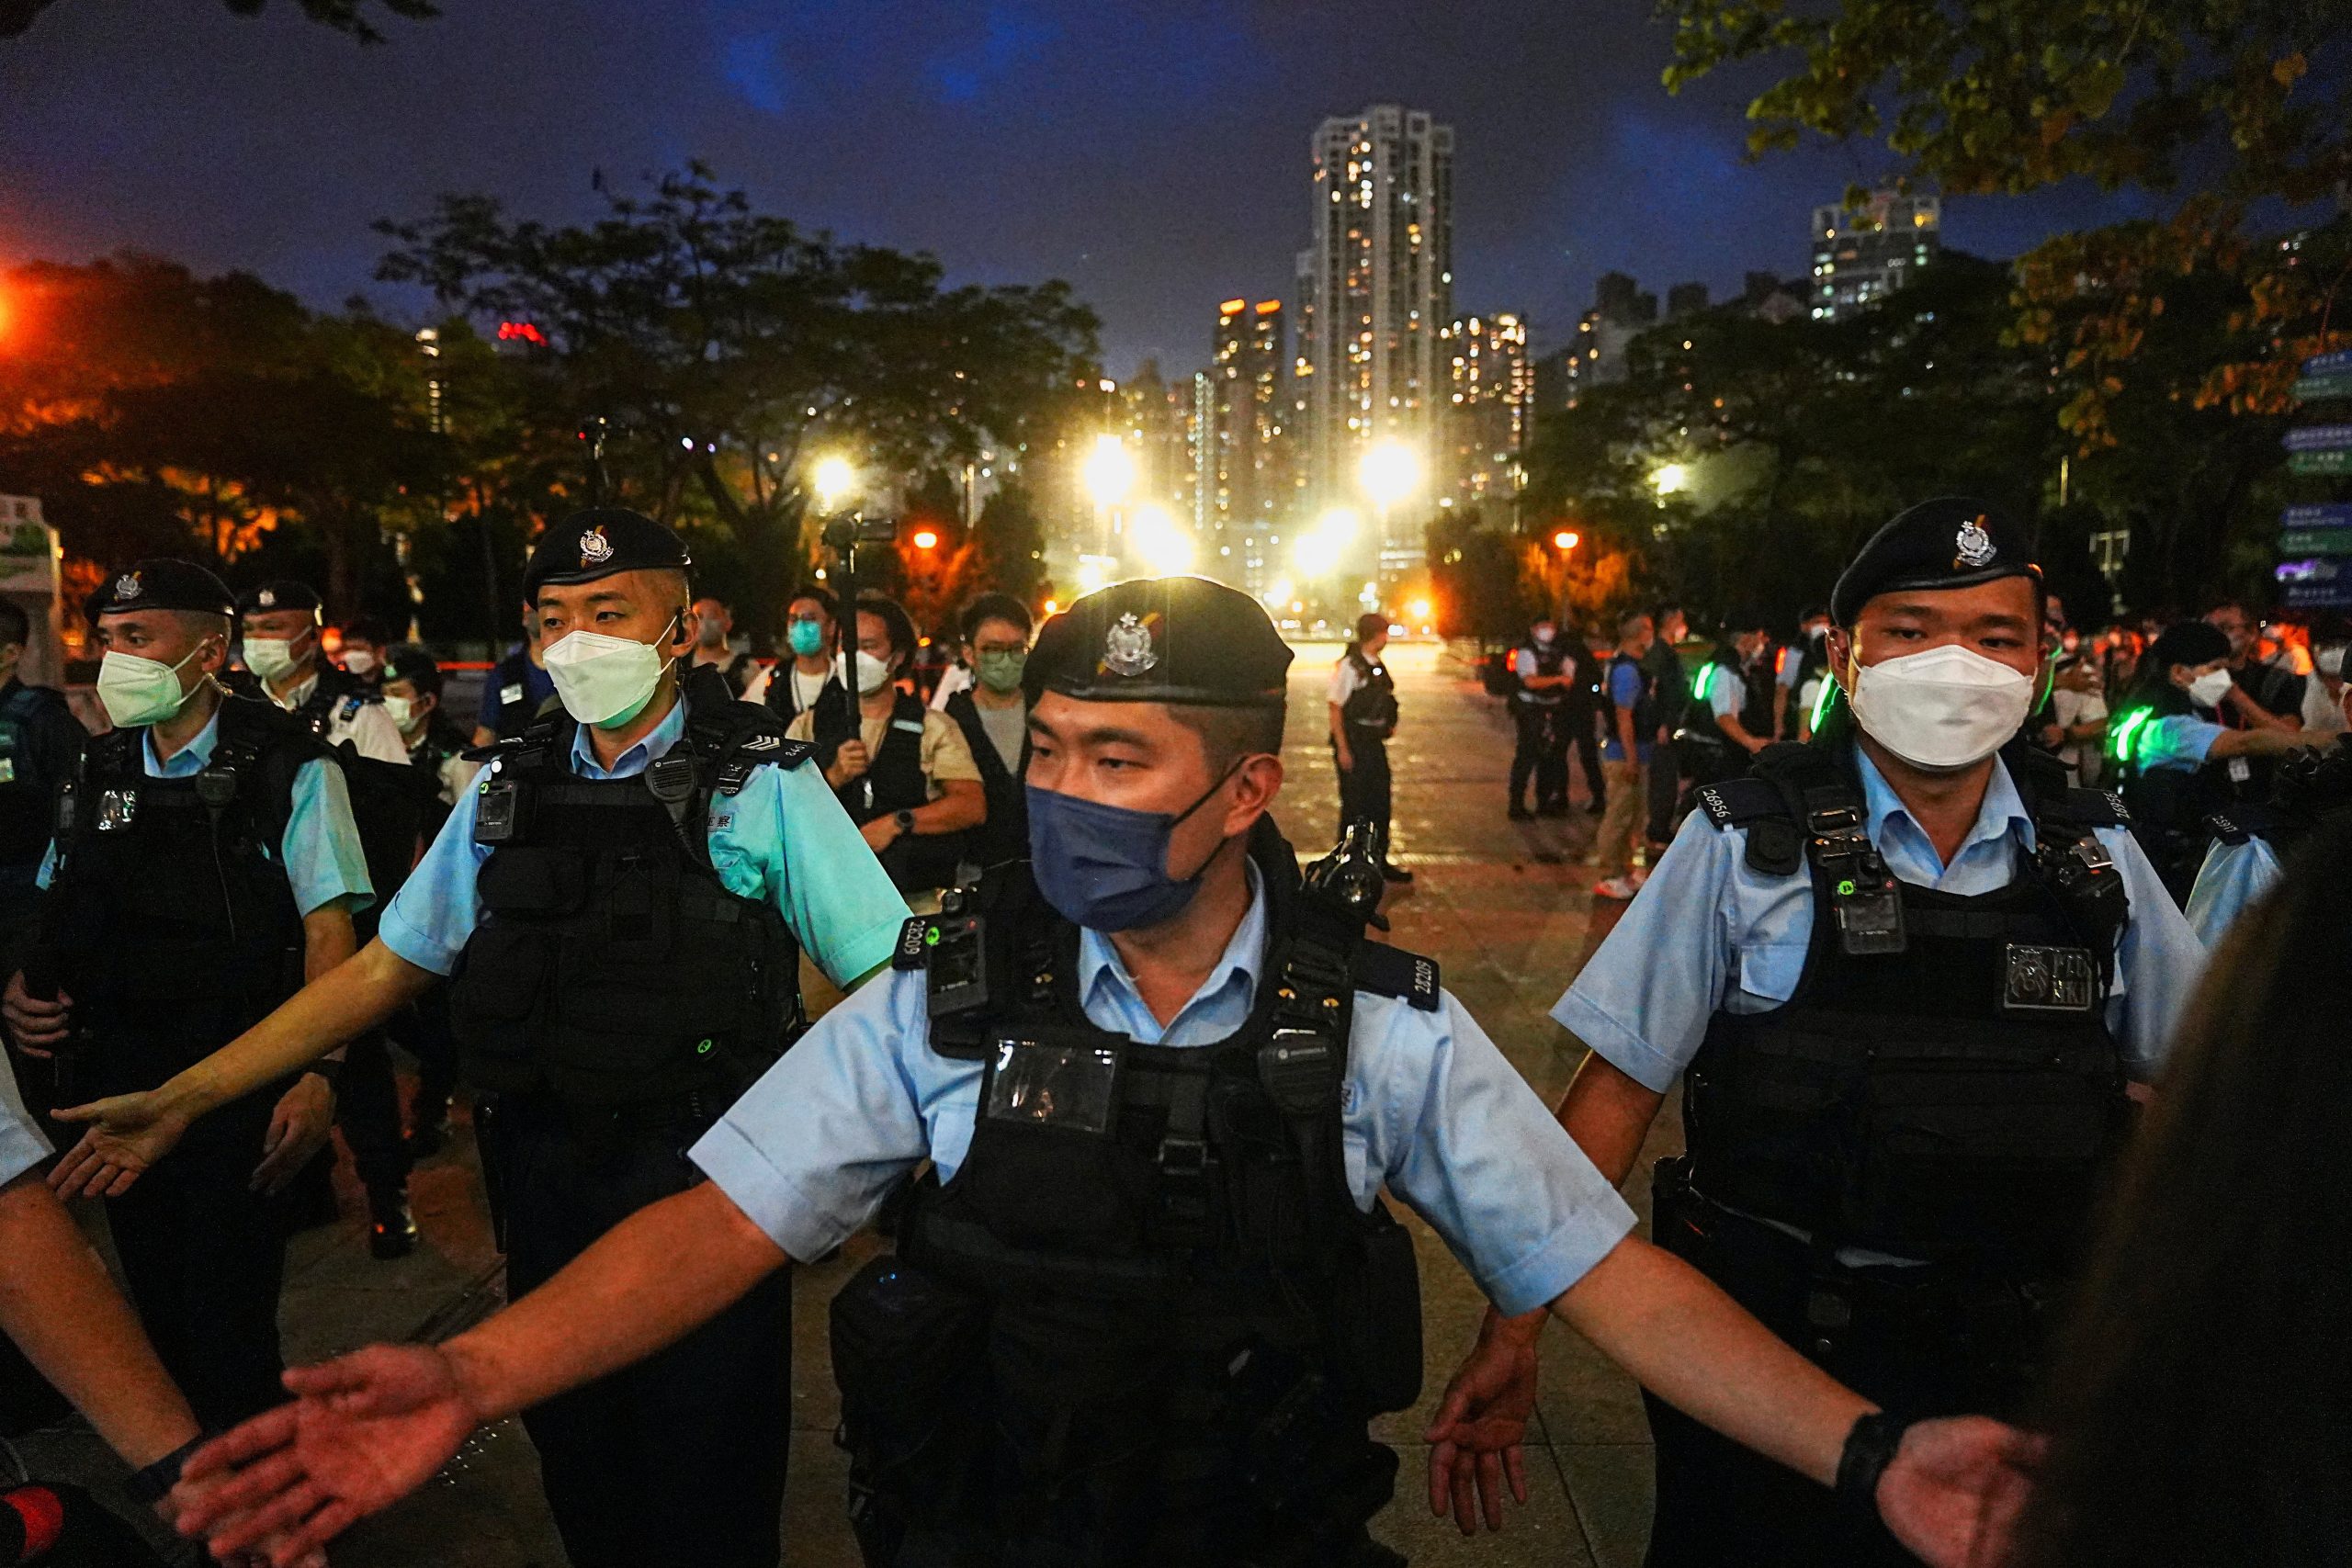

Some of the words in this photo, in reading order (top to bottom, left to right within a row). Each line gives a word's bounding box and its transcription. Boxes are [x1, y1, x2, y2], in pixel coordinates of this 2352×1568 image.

[1702, 789, 1732, 818] 26956
[2102, 792, 2132, 819] 26956
[903, 919, 925, 955] 28209
[1414, 960, 1431, 995] 28209
